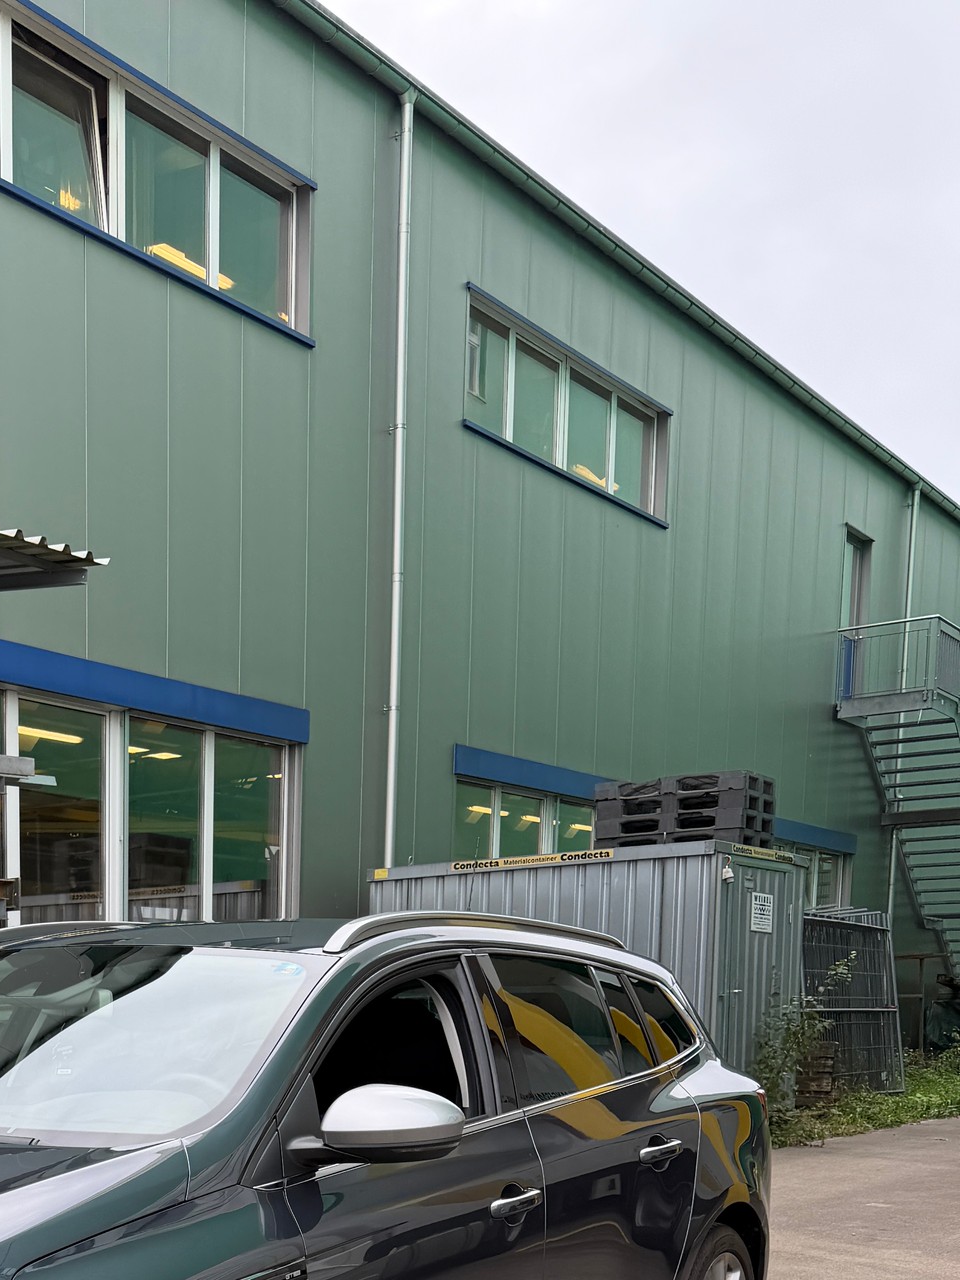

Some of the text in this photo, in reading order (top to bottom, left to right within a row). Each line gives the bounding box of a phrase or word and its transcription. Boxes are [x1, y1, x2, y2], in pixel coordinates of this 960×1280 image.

[453, 850, 610, 871] Condecta Materialcontainer Condecta
